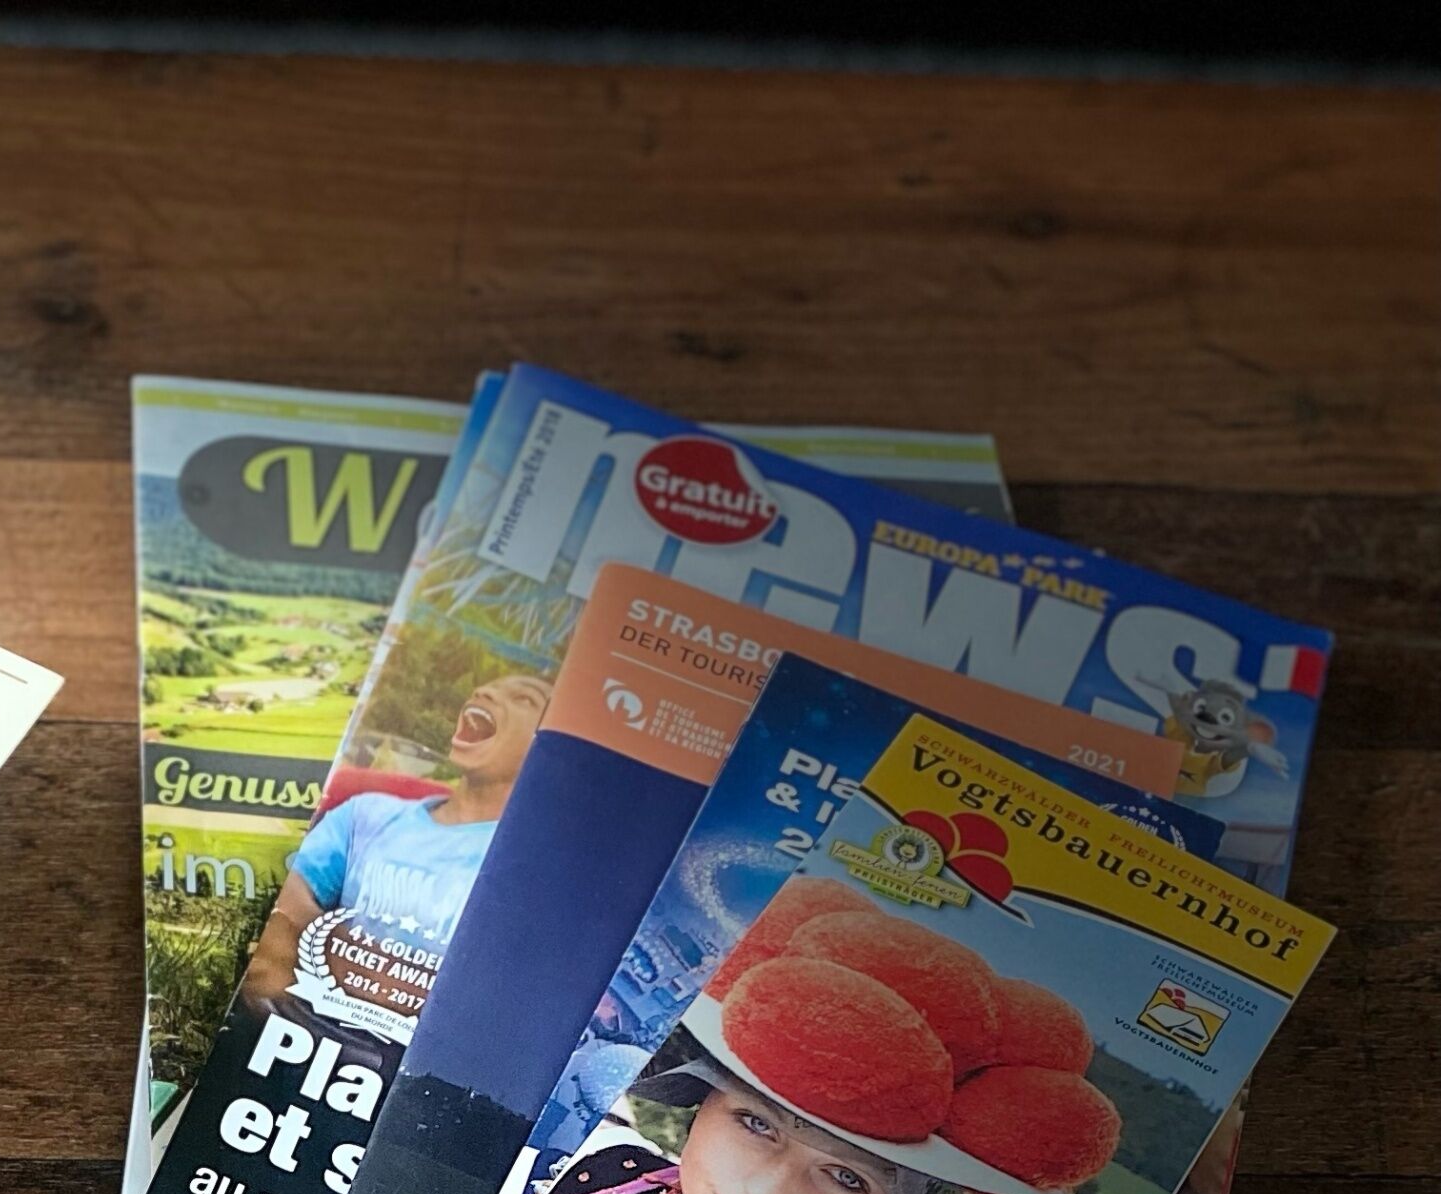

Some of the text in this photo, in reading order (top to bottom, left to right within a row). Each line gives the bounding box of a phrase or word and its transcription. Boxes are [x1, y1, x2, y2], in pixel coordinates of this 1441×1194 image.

[639, 463, 778, 520] Gratuit
[669, 500, 750, 529] emporter
[871, 519, 1111, 610] EUROPA PARK
[618, 624, 670, 657] DER
[1066, 743, 1127, 777] 2021
[765, 781, 801, 814] &
[159, 835, 256, 900] im
[911, 744, 1303, 964] Vogtsbauernhof
[1106, 832, 1306, 939] FREILICHTMUSEUM
[330, 936, 389, 973] TICKET
[343, 971, 380, 995] 2014
[387, 988, 426, 1010] 2017
[247, 1012, 384, 1123] Pla
[1114, 1016, 1220, 1076] VOGTSBAUERNHOF
[219, 1097, 312, 1174] et
